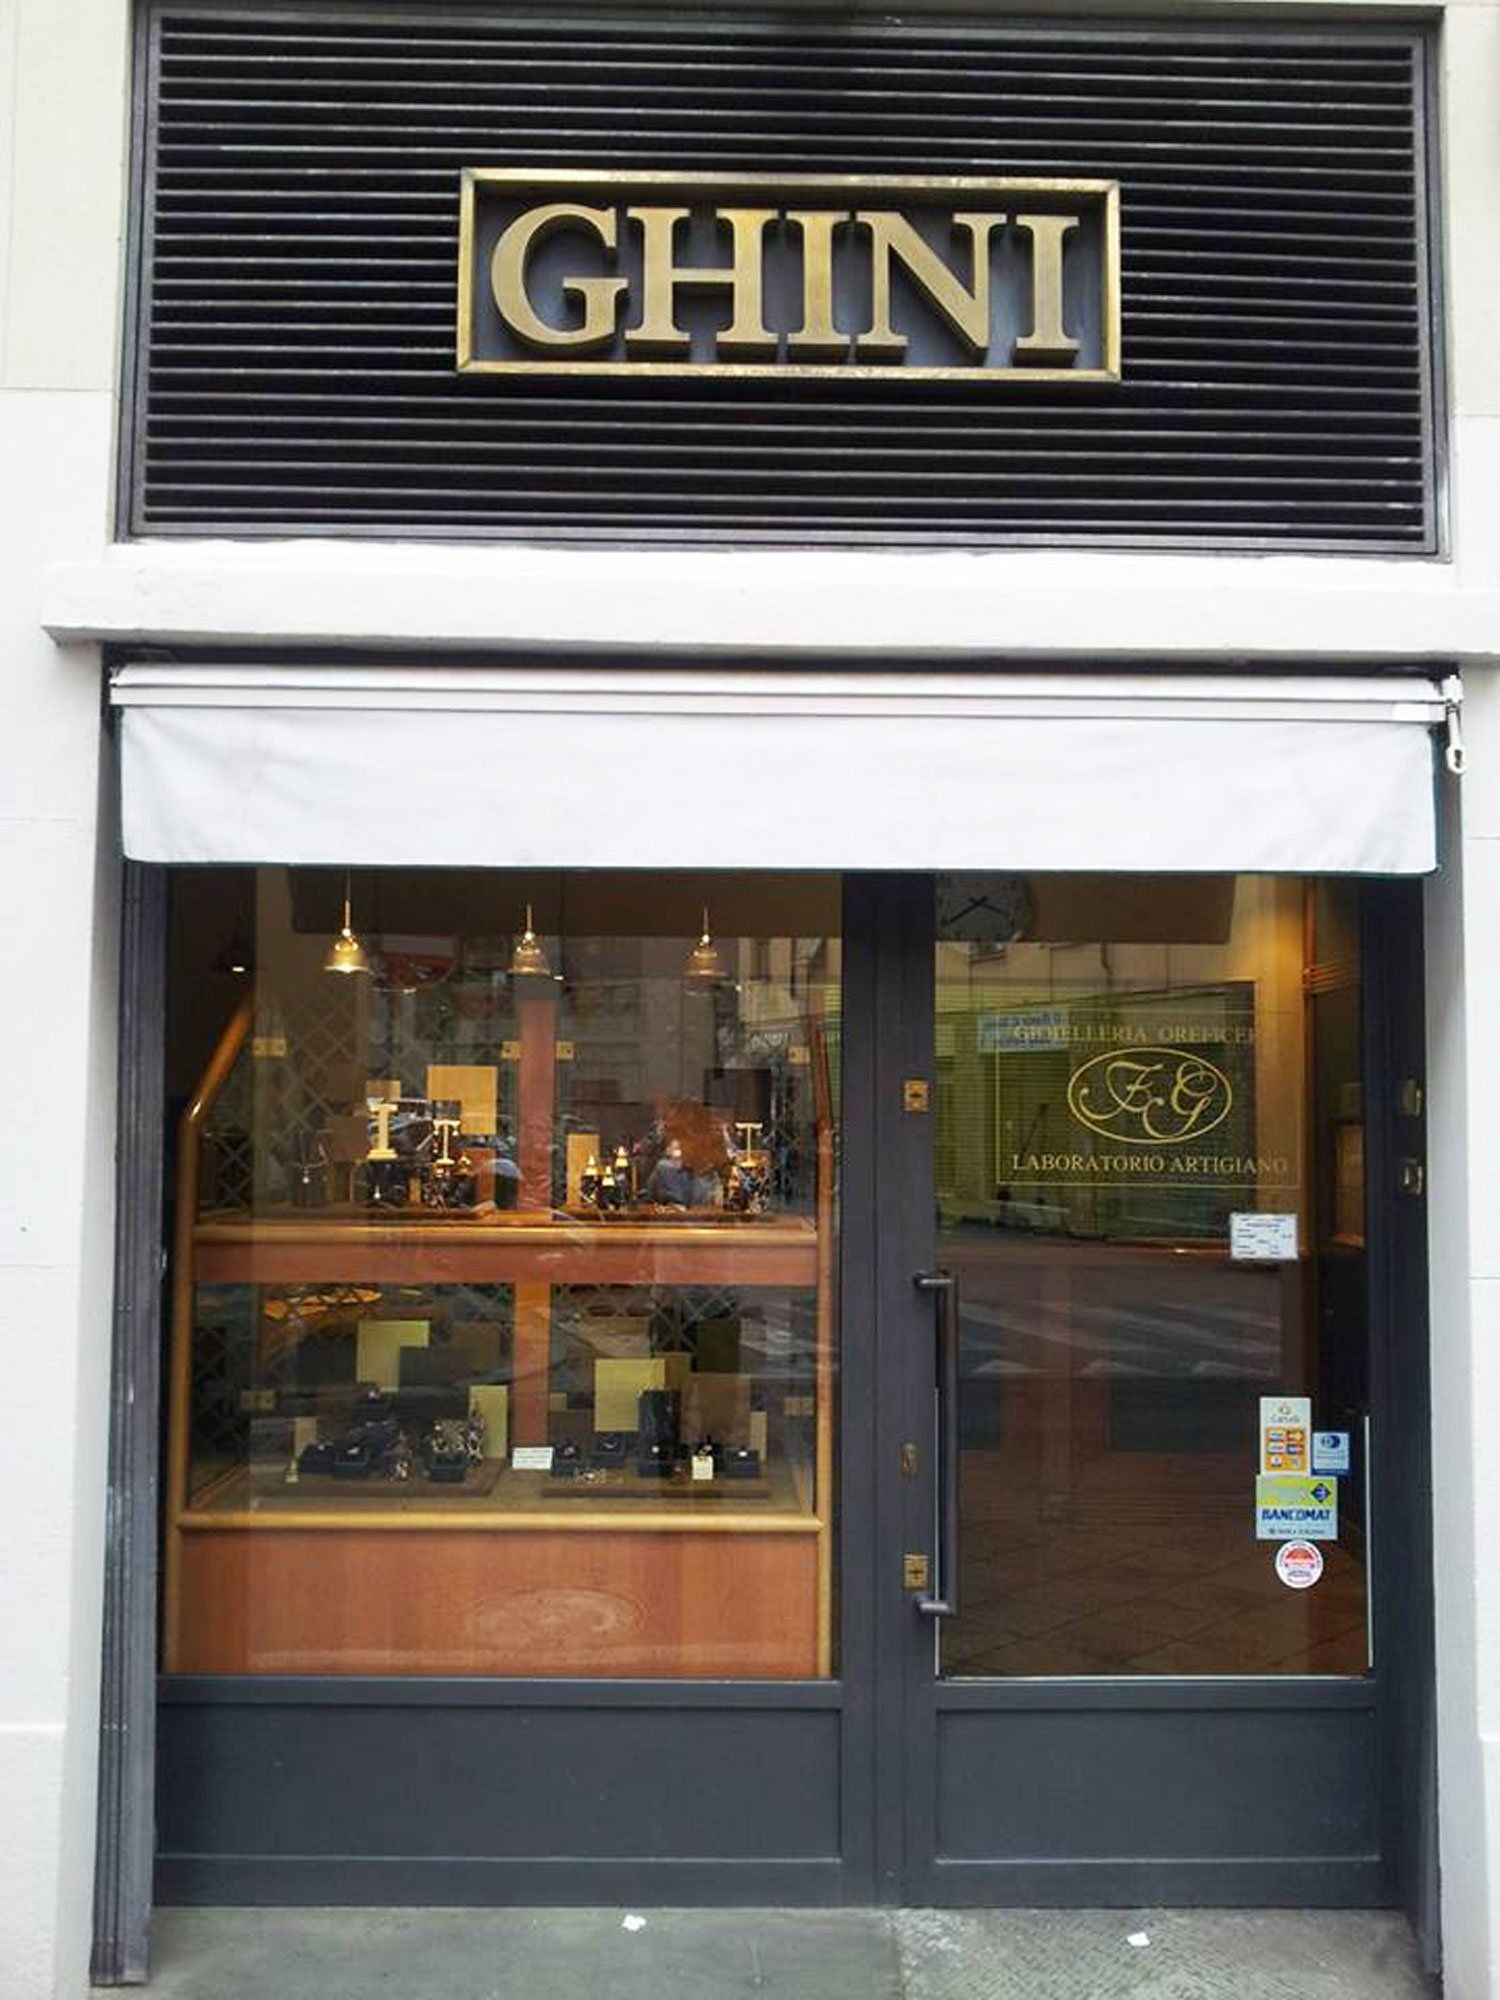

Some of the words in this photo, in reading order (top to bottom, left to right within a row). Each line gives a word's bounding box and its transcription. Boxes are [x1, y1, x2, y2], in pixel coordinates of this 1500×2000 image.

[491, 203, 1080, 350] GHINI
[1014, 1024, 1147, 1042] GIOIELLERIA
[1012, 1154, 1165, 1173] LABORATORIO
[1169, 1155, 1288, 1175] ARTIGIANO
[1262, 1508, 1331, 1522] BANCOMAT
